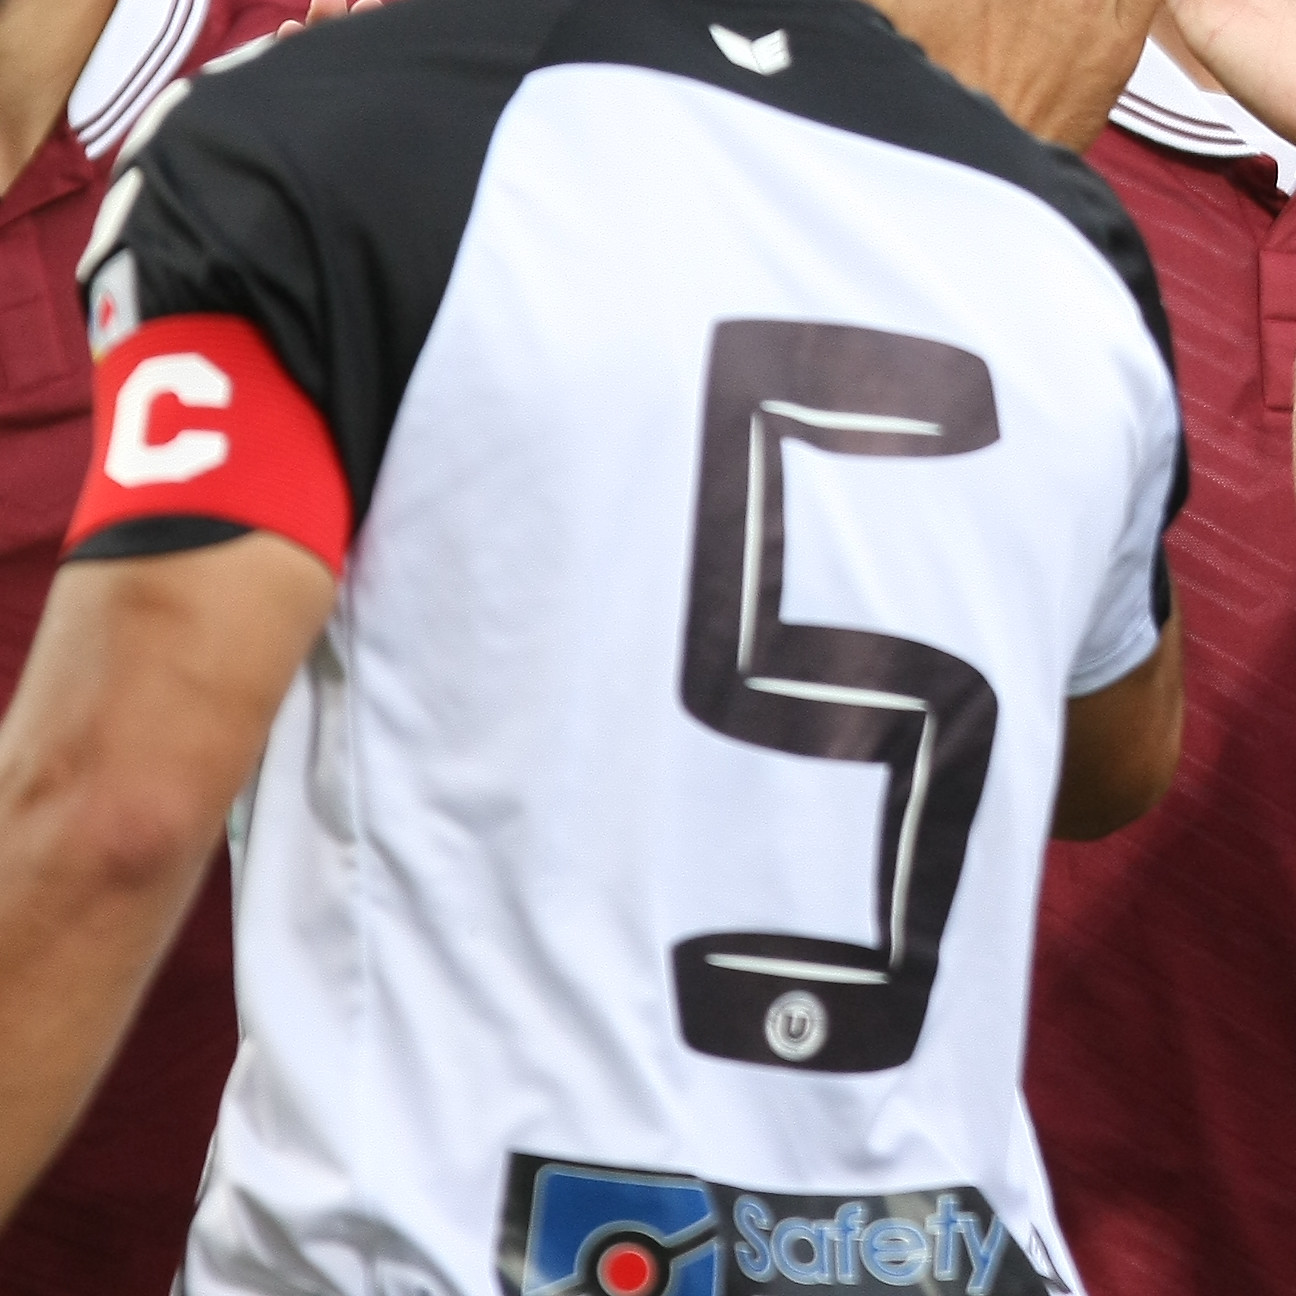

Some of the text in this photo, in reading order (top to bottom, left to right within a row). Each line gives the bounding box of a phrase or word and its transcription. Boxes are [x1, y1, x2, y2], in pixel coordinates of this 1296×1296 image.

[104, 352, 233, 488] C
[671, 318, 1001, 1074] 5
[733, 1194, 1006, 1296] Safety
